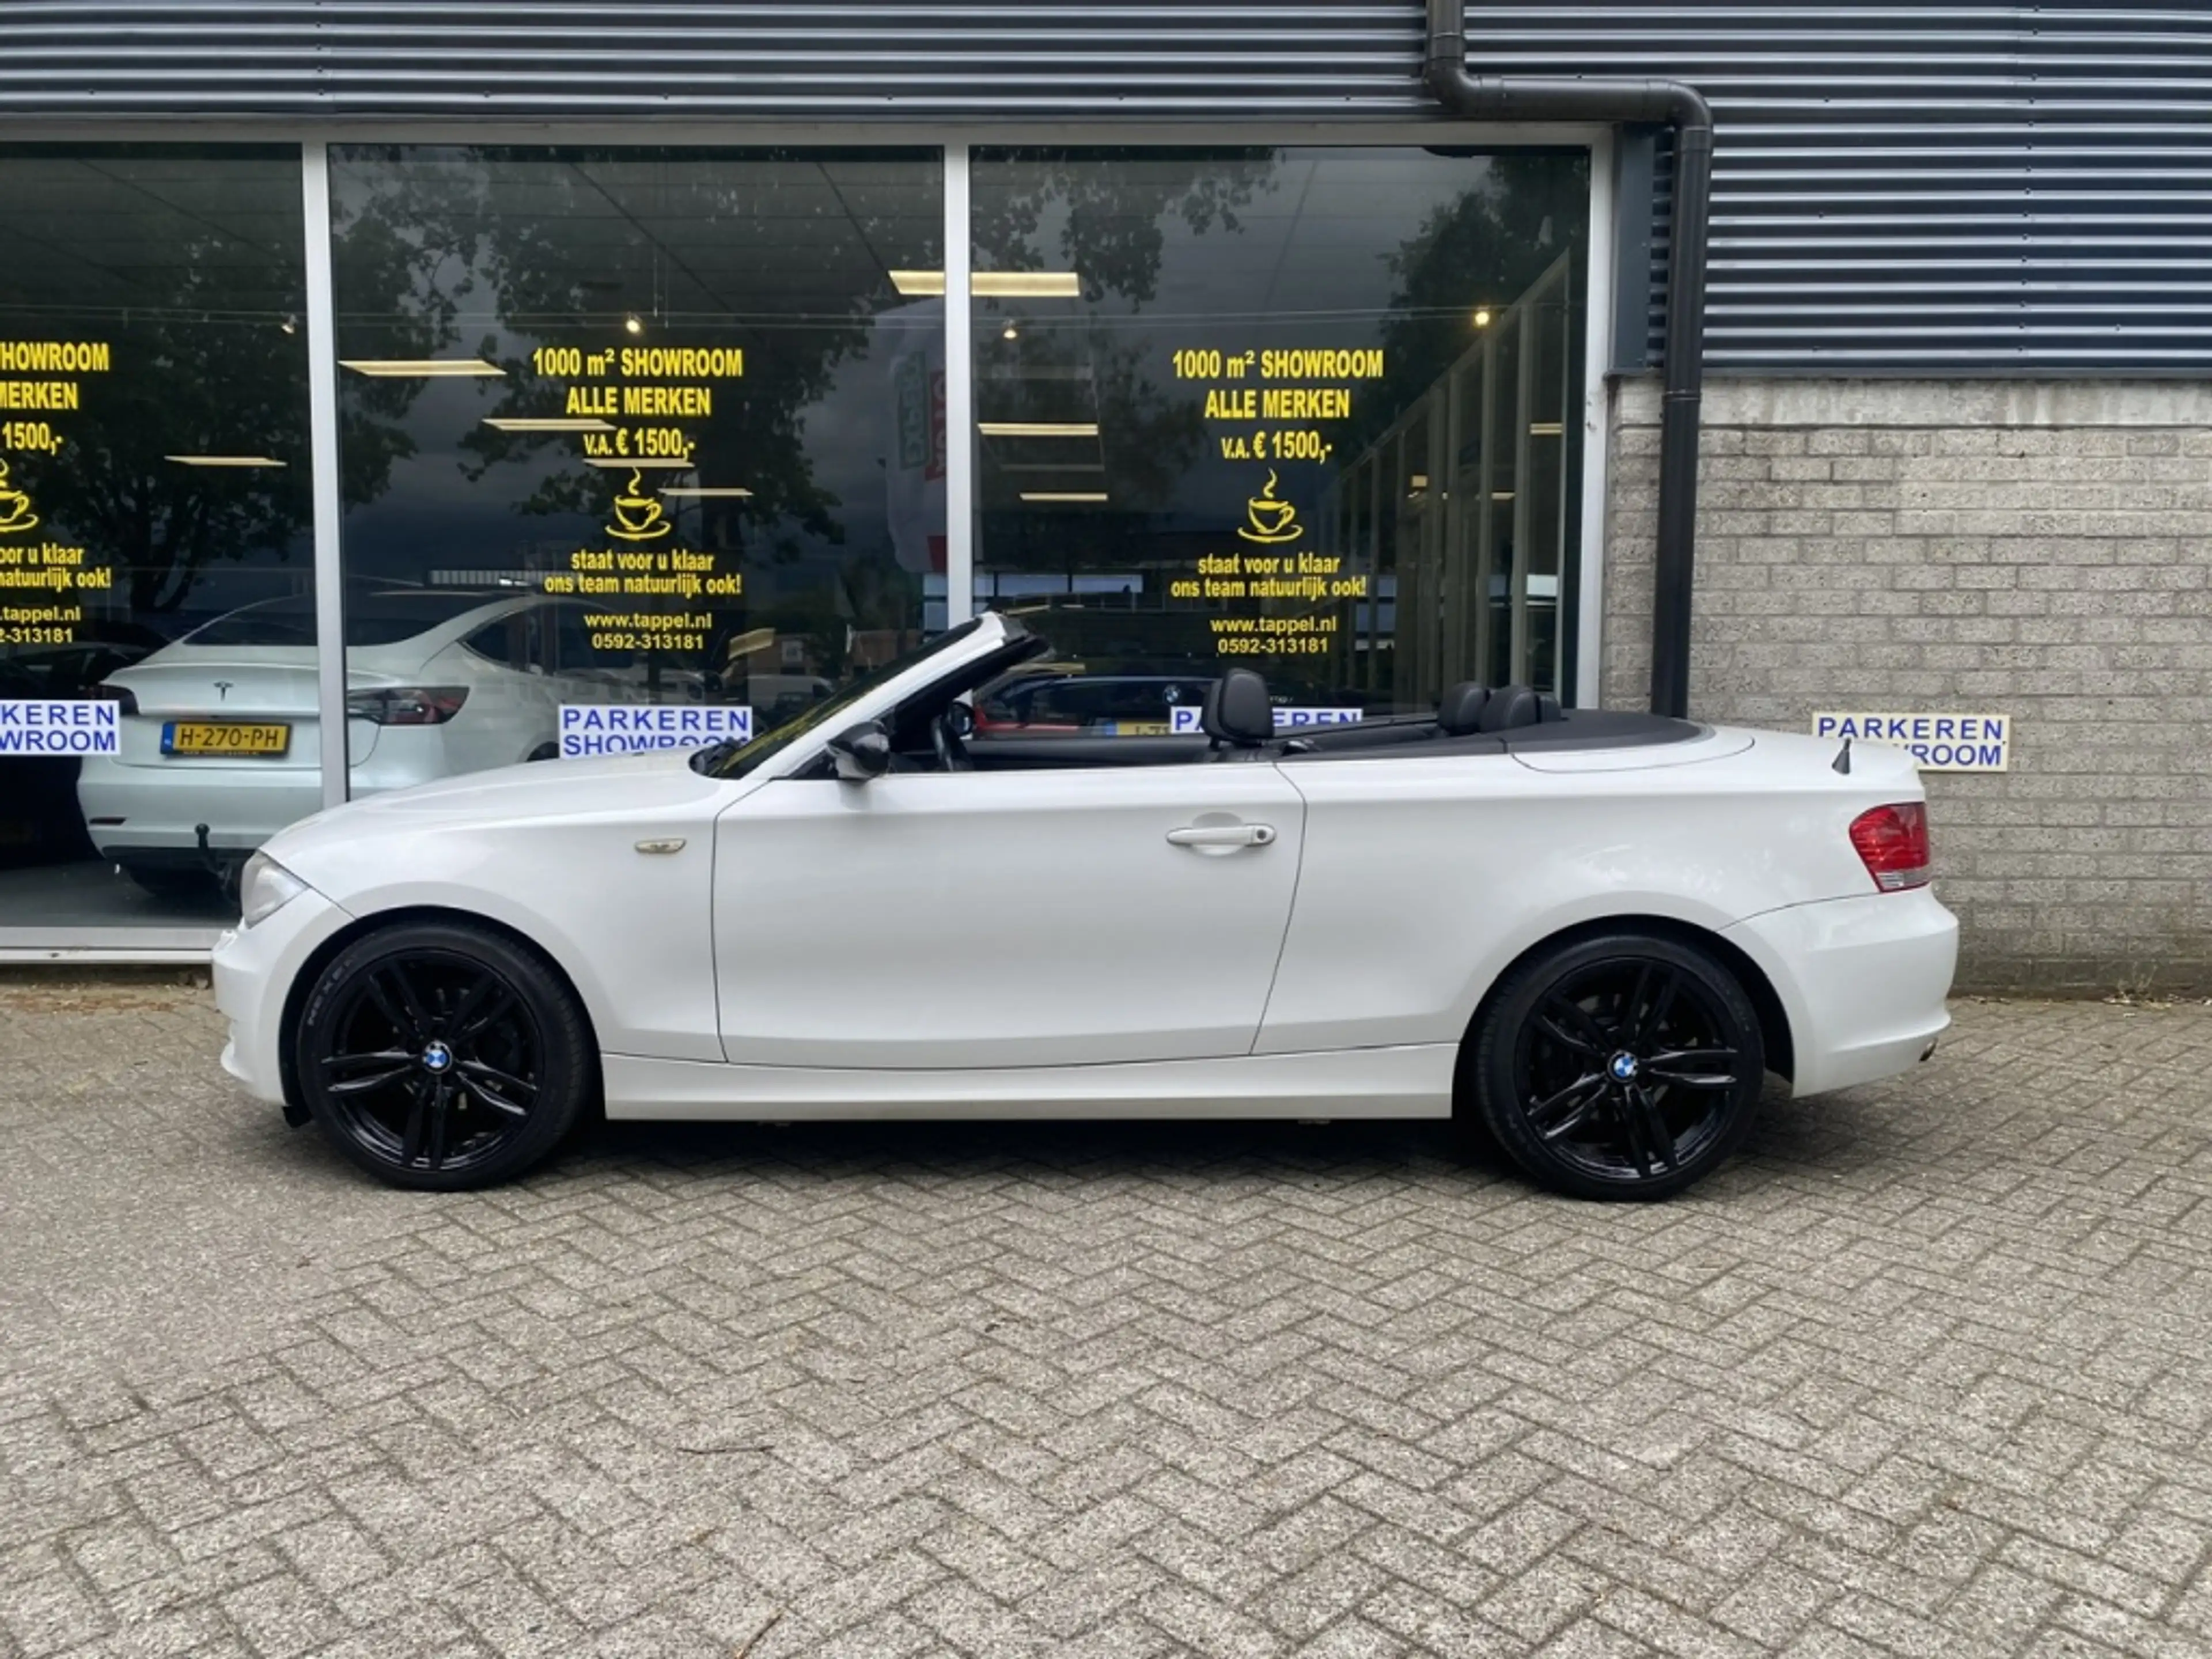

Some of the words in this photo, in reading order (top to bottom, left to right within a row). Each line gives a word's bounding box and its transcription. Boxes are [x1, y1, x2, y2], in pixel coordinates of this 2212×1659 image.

[0, 341, 110, 371] HOWROOM
[533, 349, 581, 377] 1000
[621, 348, 744, 377] SHOWROOM
[1173, 350, 1221, 378] 1000
[1261, 350, 1384, 378] SHOWROOM
[566, 387, 619, 416] ALLE
[623, 387, 712, 416] MERKEN
[1205, 389, 1256, 419] ALLE
[1262, 389, 1351, 419] MERKEN
[2, 422, 63, 456] 1500,-
[584, 435, 613, 456] V.A.
[615, 428, 629, 456] €
[634, 428, 696, 461] 1500,-
[1222, 437, 1249, 459] V.A.
[1252, 431, 1267, 459] €
[1272, 430, 1332, 463] 1500,-
[28, 548, 39, 564] u
[42, 543, 84, 565] klaar
[571, 550, 614, 570] staat
[618, 554, 652, 571] voor
[657, 555, 668, 571] u
[672, 550, 714, 571] klaar
[1198, 553, 1240, 574] staat
[1244, 557, 1279, 574] voor
[1284, 558, 1295, 574] u
[1298, 552, 1340, 574] klaar
[77, 567, 111, 588] ook!
[545, 577, 574, 592] ons
[578, 574, 620, 593] team
[624, 573, 702, 597] natuurlijk
[707, 574, 741, 594] ook!
[1171, 580, 1200, 597] ons
[1205, 577, 1245, 597] team
[1251, 576, 1327, 600] natuurlijk
[1332, 577, 1367, 597] ook!
[584, 613, 712, 631] www.tappel.nl
[1210, 617, 1337, 636] www.tappel.nl
[592, 635, 703, 649] 0592-313181
[1218, 639, 1328, 653] 0592-313181
[1, 704, 114, 725] KEREN
[563, 709, 748, 731] PARKEREN
[179, 728, 279, 747] H-270-PH
[1818, 717, 2003, 740] PARKEREN
[1903, 744, 2001, 766] ROOM
